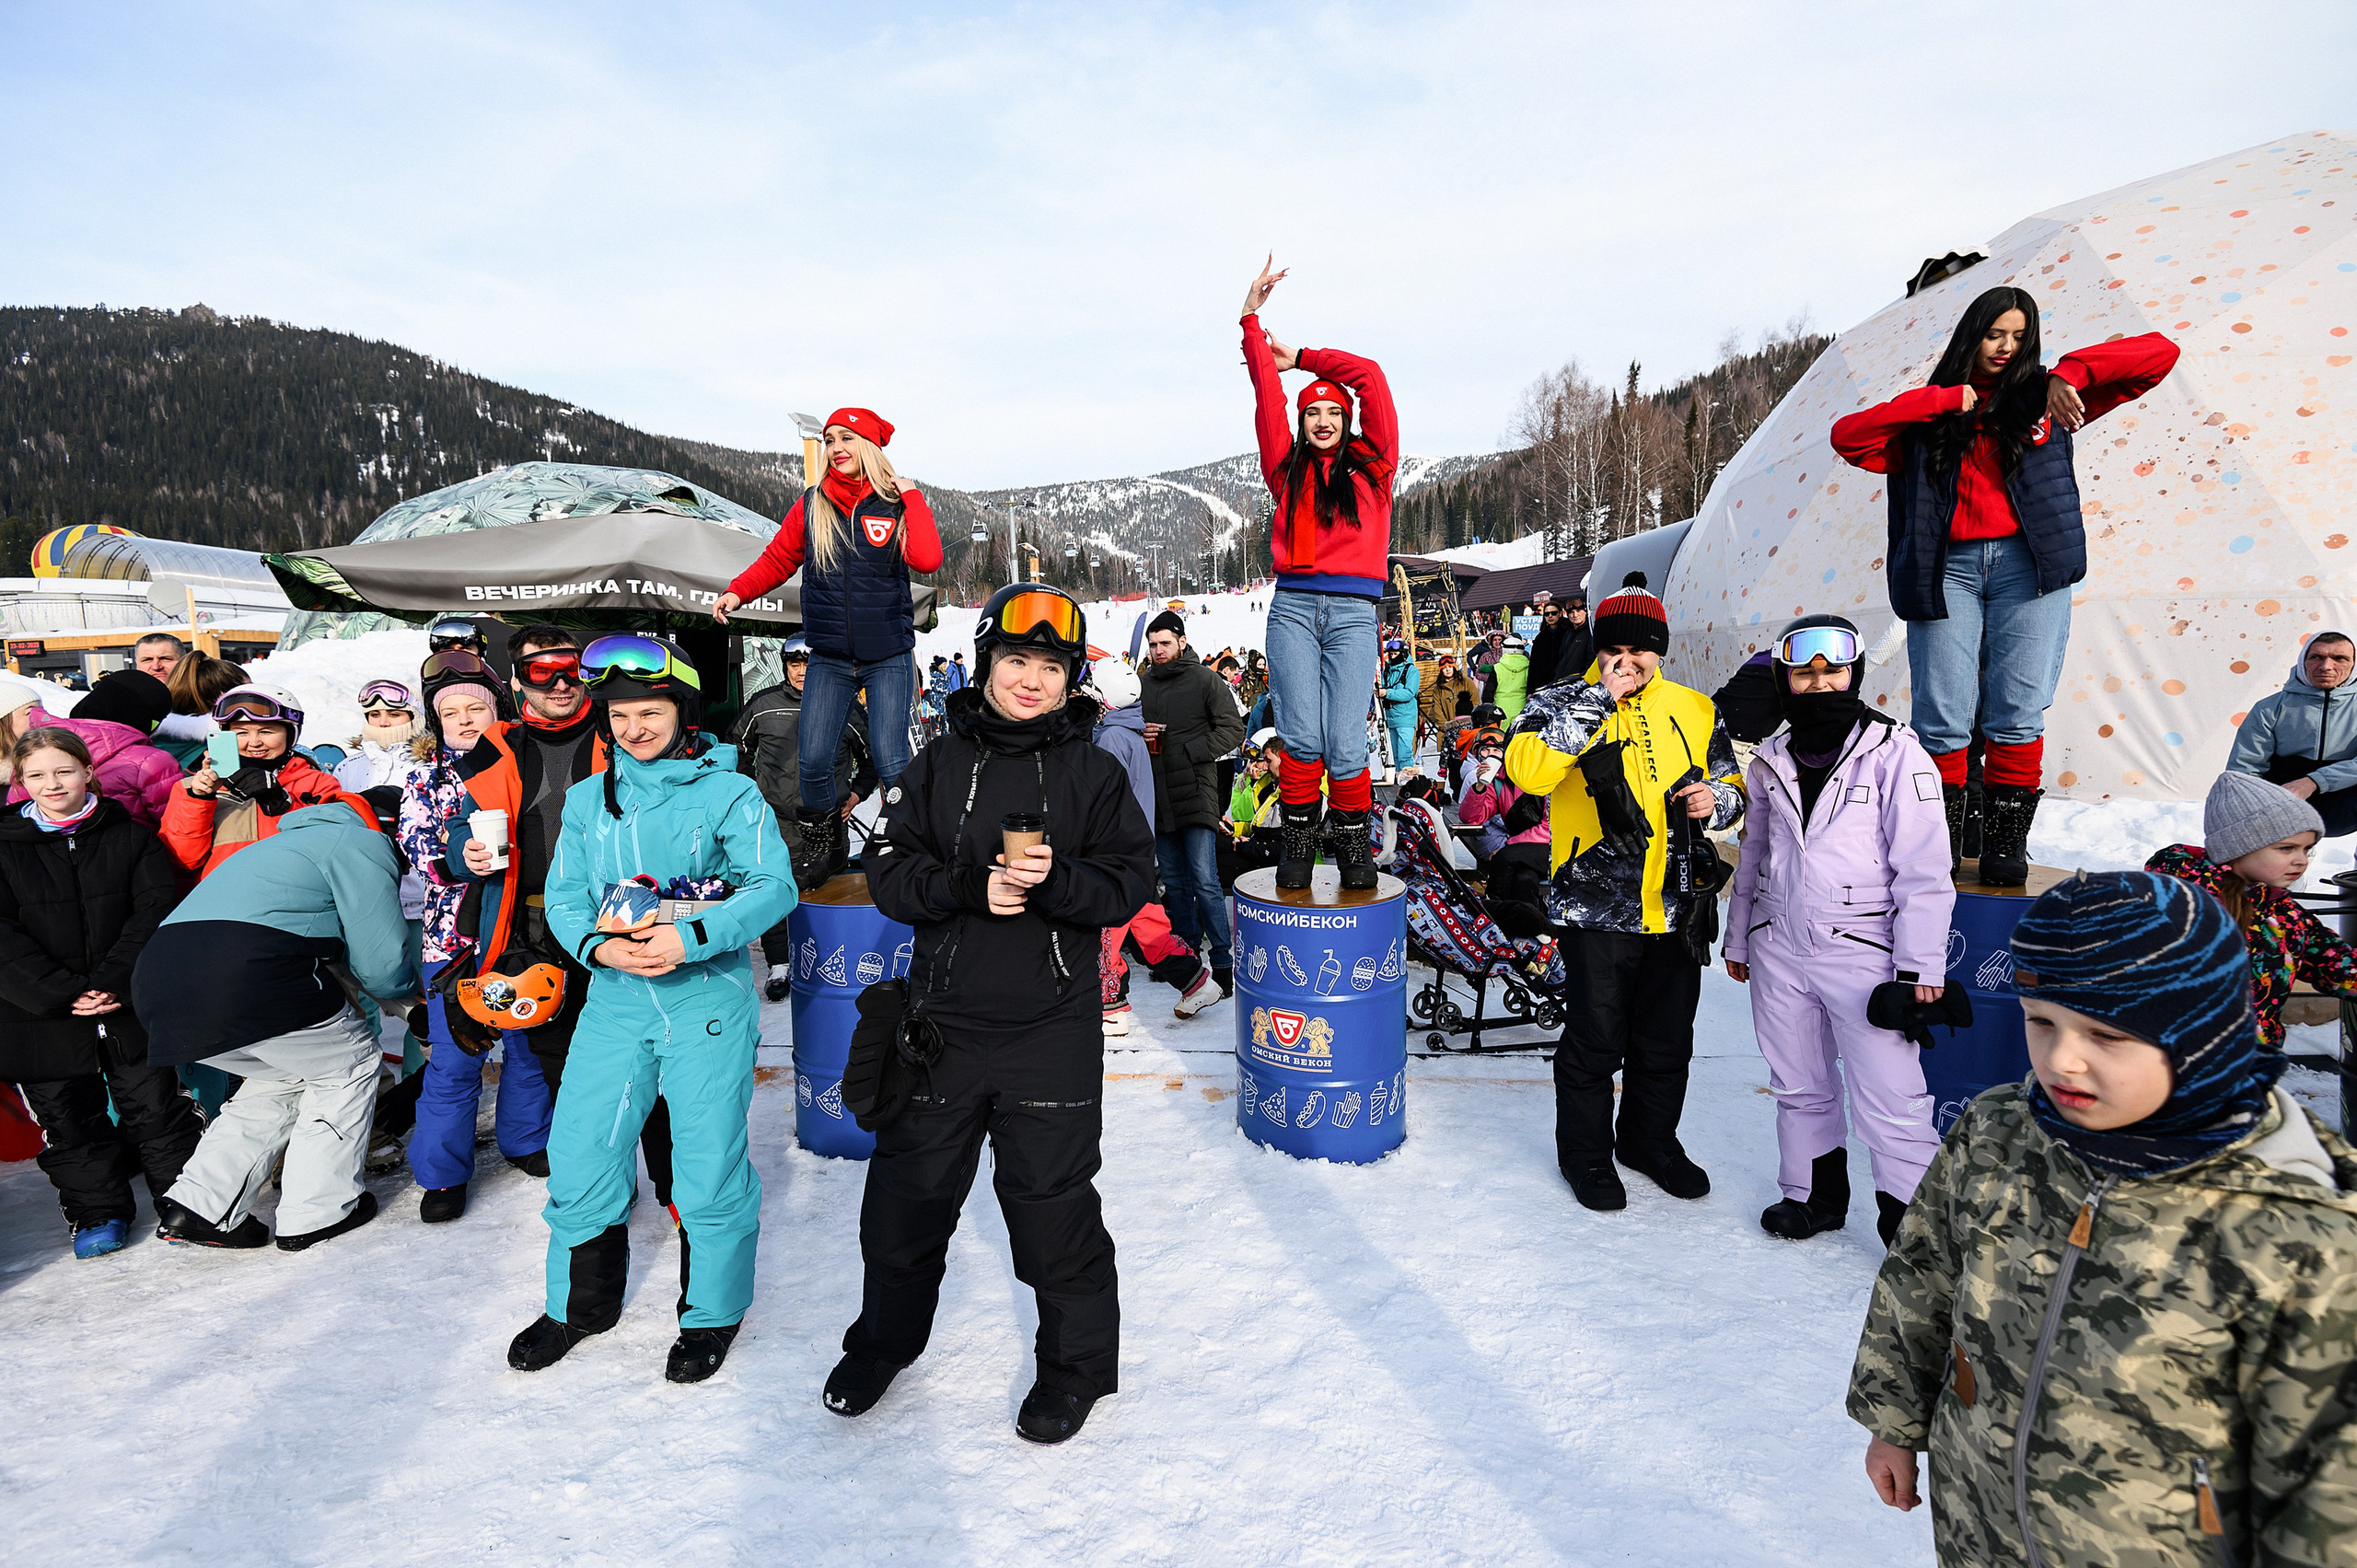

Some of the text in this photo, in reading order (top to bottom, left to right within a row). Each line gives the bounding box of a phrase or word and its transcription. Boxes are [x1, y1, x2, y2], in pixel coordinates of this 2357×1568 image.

[464, 579, 784, 613] ВЕЧЕРИНКА ТАМ, ГД МЫ
[1237, 902, 1357, 929] #ОМСКИЙБЕКОН
[1251, 1045, 1332, 1067] ОМСКИЙ БЕКОН
